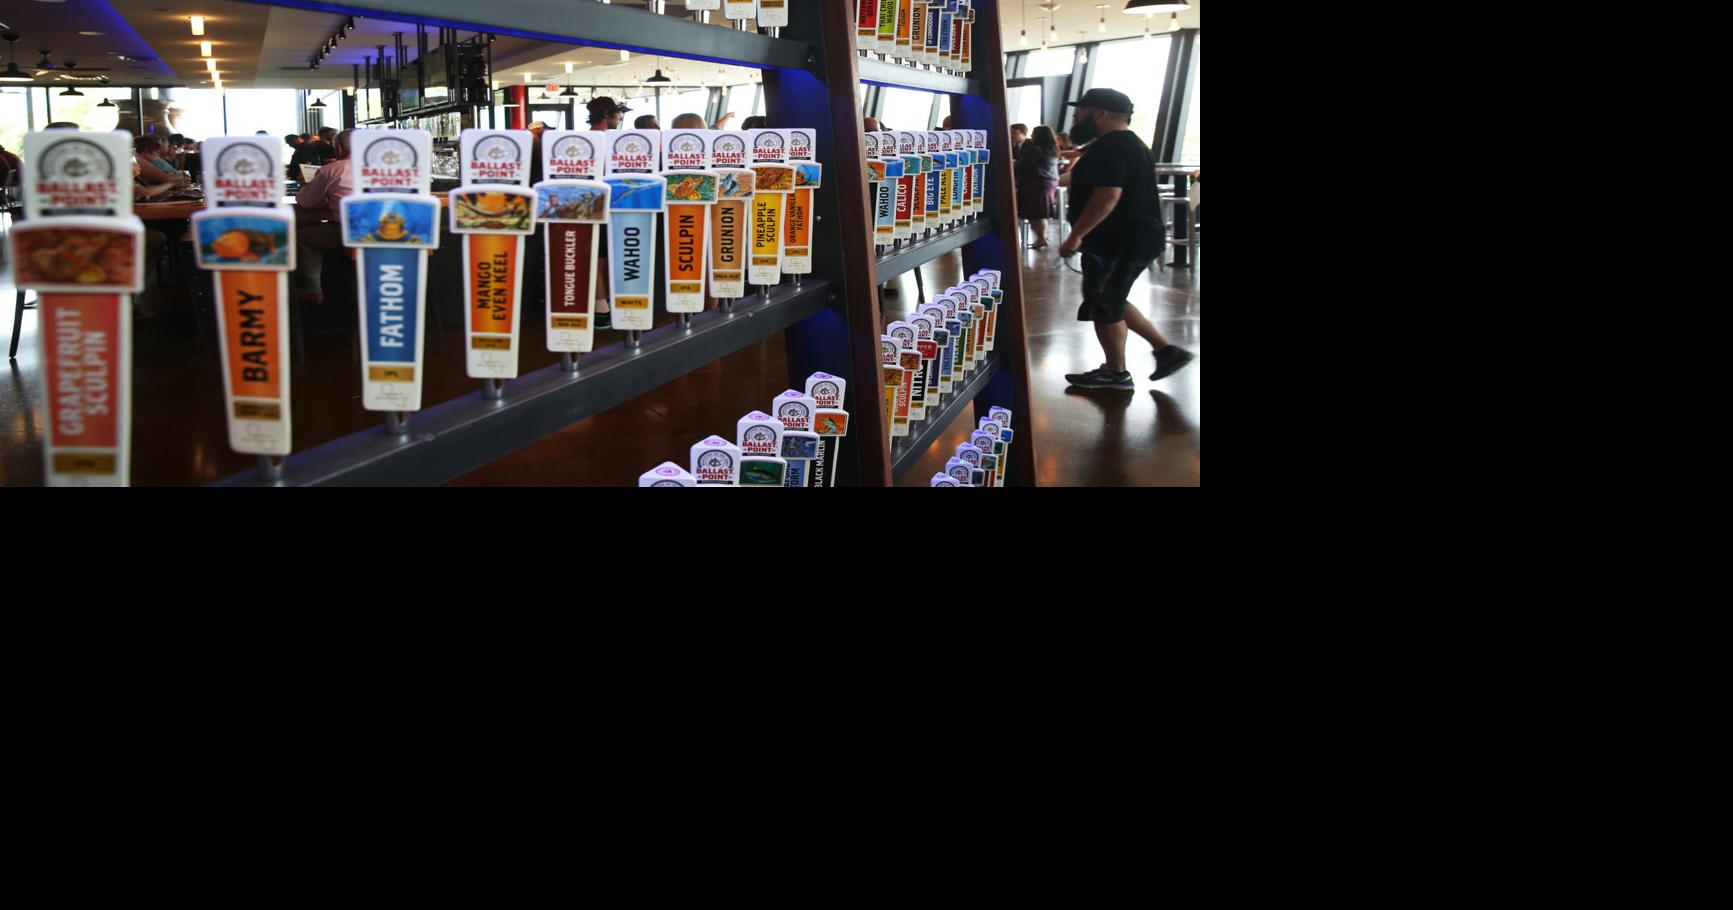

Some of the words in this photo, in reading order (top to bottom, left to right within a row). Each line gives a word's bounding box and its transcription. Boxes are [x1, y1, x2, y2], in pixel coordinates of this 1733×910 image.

[912, 8, 920, 40] GRUNION
[362, 167, 420, 177] BALLAST
[370, 178, 412, 186] POINT
[470, 161, 522, 170] BALLAST
[36, 180, 117, 194] BALLAST
[214, 178, 276, 188] BALLAST
[223, 190, 268, 198] POINT
[897, 184, 907, 212] CALICO
[50, 196, 108, 206] POINT
[880, 186, 889, 218] WAHOO
[720, 207, 734, 262] GRUNION
[756, 202, 766, 248] PINEAPPLE
[766, 208, 775, 242] SCULPIN
[565, 230, 576, 270] BUCKLER
[624, 226, 640, 282] WAHOO
[678, 214, 694, 272] SCULPIN
[494, 251, 508, 284] KEEL
[476, 262, 491, 309] MANGO
[564, 272, 576, 307] TONGUE
[380, 264, 404, 348] FATHOM
[492, 287, 506, 320] EVEN
[238, 290, 268, 382] BARMY
[56, 308, 85, 436] GRAPEFRUIT
[81, 331, 108, 416] SCULPIN
[816, 440, 826, 467] MARLIN
[790, 468, 800, 488] TORM
